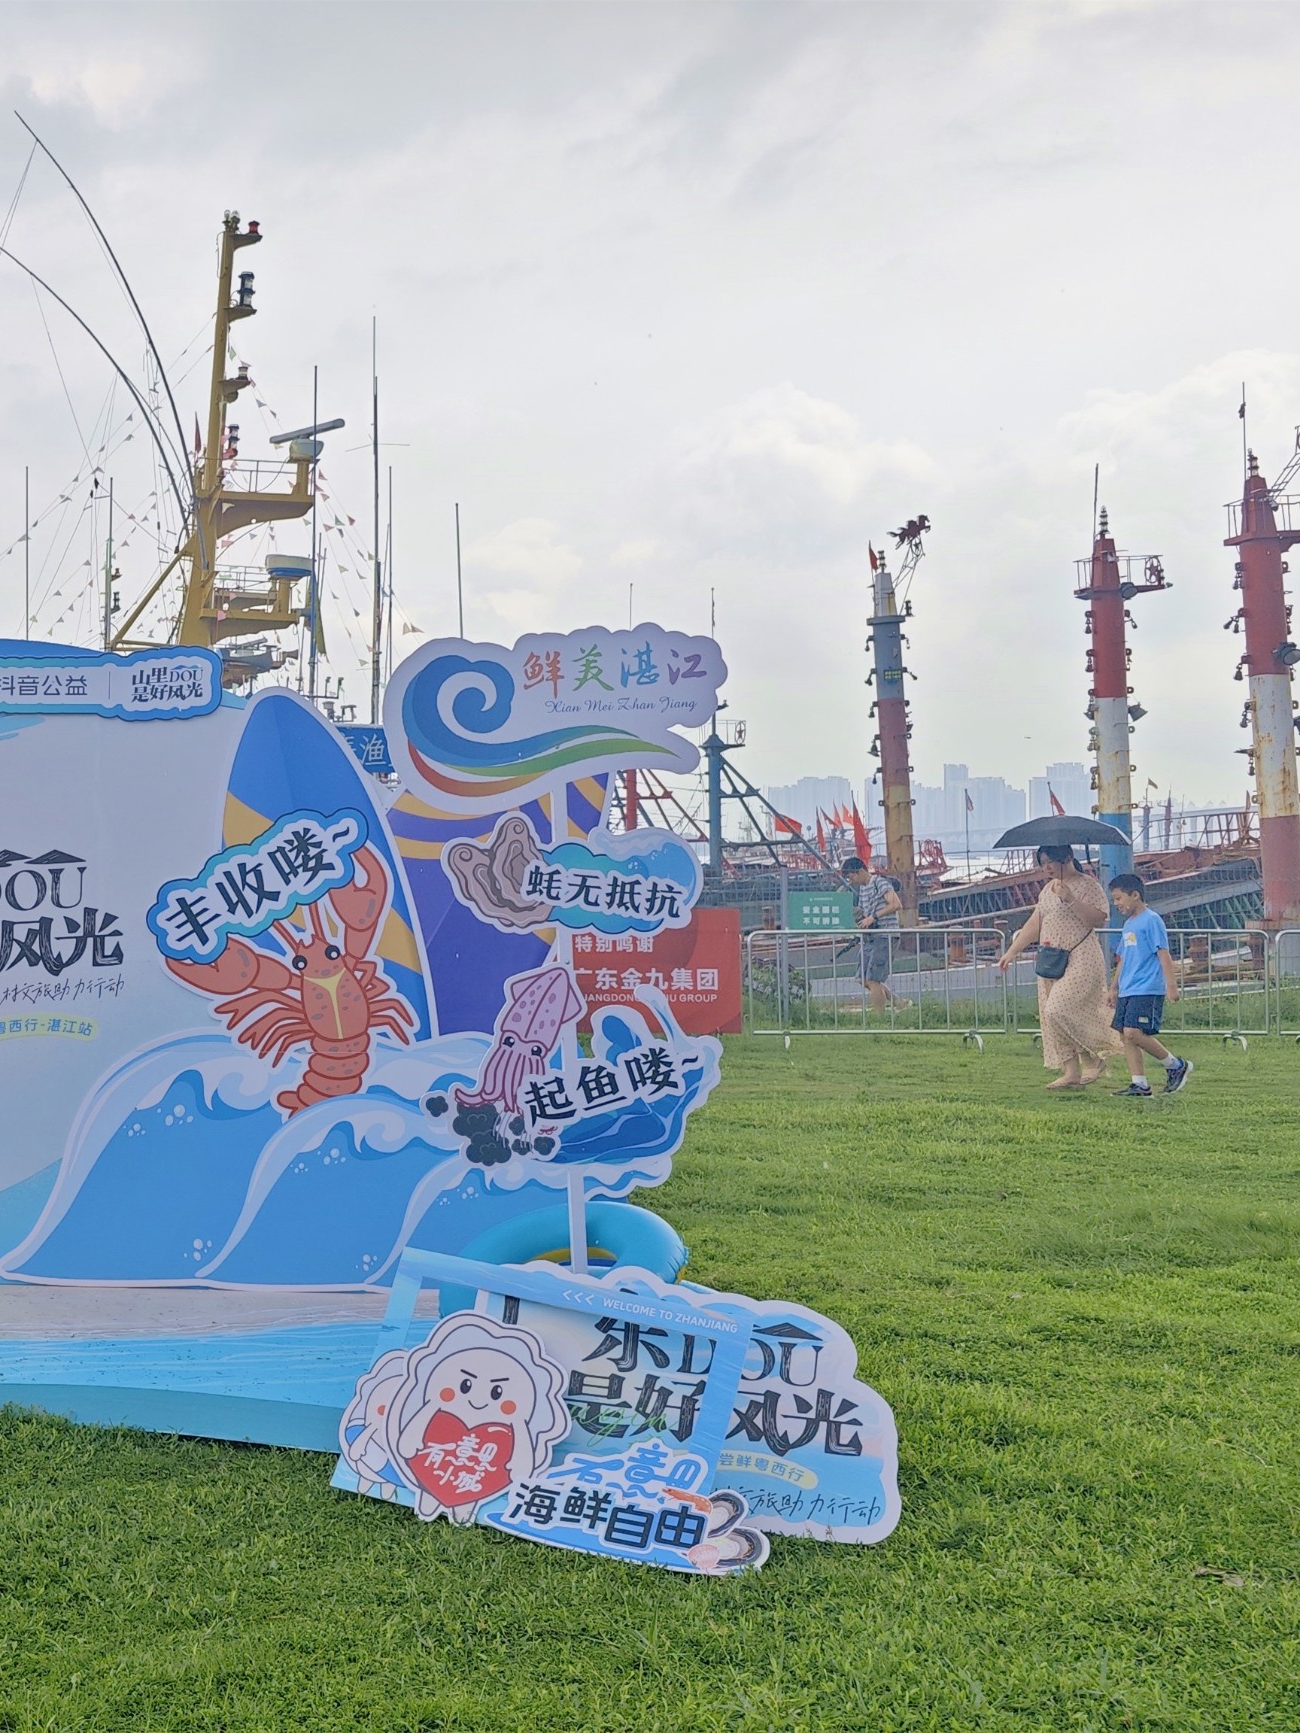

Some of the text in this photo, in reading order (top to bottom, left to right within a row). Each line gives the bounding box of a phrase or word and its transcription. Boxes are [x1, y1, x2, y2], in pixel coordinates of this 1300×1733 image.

[131, 665, 204, 685] 山里DOU
[522, 641, 708, 699] 鲜美湛江
[131, 682, 204, 703] 是好风光
[545, 696, 698, 713] Xian Mei Zhan Jiang
[526, 865, 683, 919] 蚝无抵抗
[574, 934, 655, 953] 特别鸣谢
[678, 993, 718, 1003] GROUP
[603, 1297, 738, 1334] WELCOME TO ZHANJIANG
[508, 1482, 706, 1549] 海鲜自由
